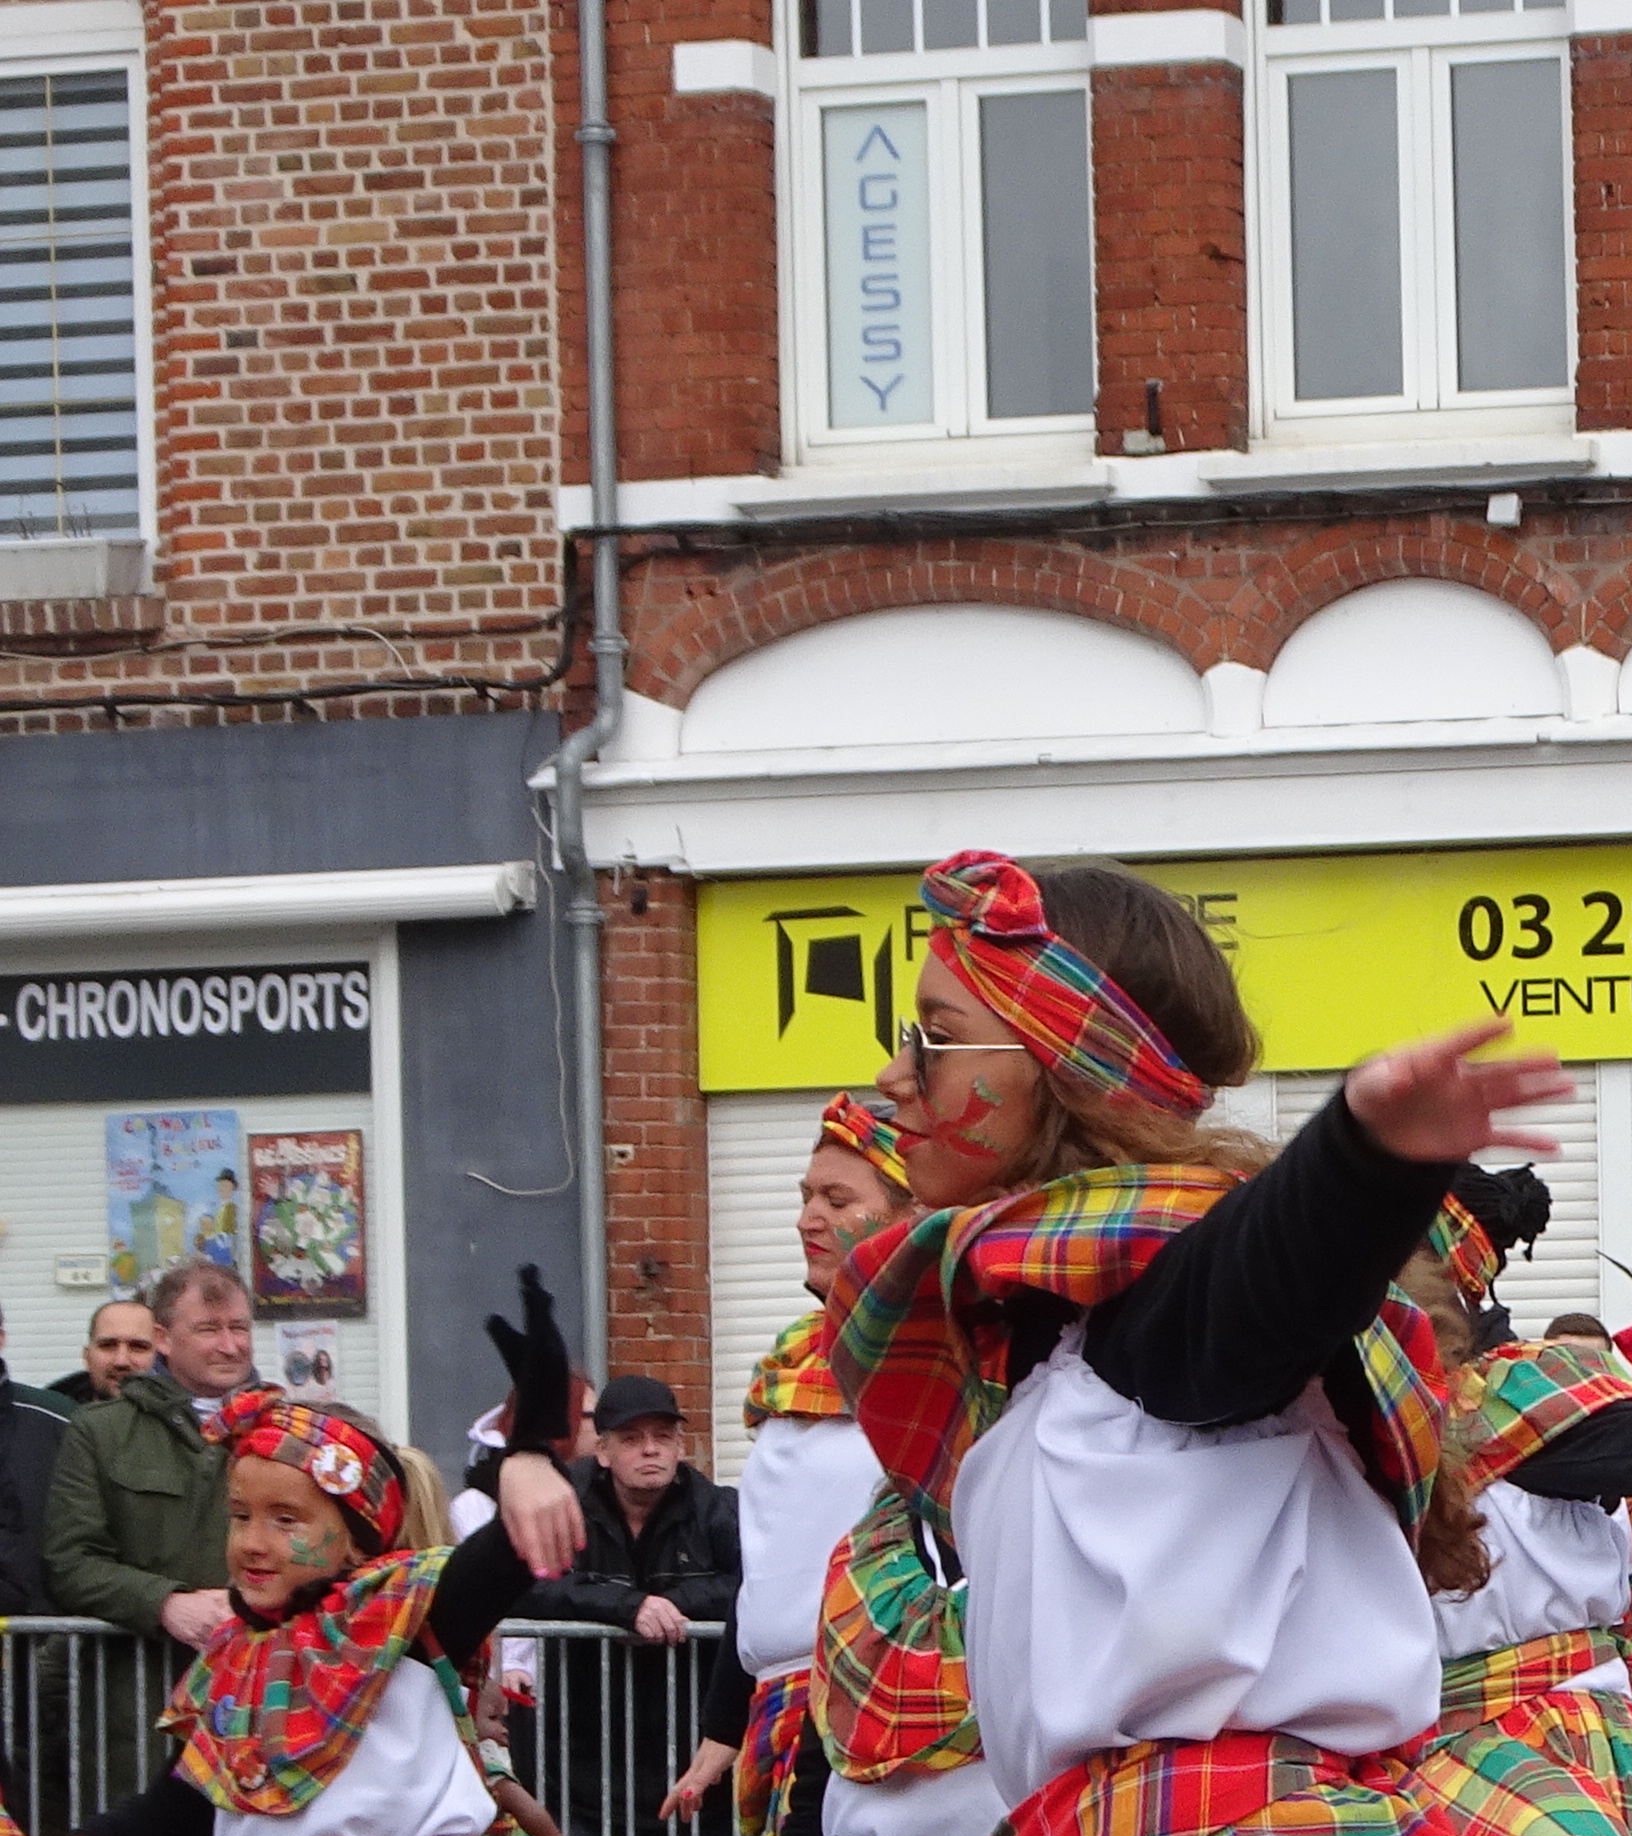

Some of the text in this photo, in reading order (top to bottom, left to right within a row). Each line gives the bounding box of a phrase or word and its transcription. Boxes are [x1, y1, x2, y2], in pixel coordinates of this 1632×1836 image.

[856, 124, 905, 412] AGESSY
[1458, 894, 1553, 962] 03
[16, 971, 370, 1042] CHRONOSPORTS
